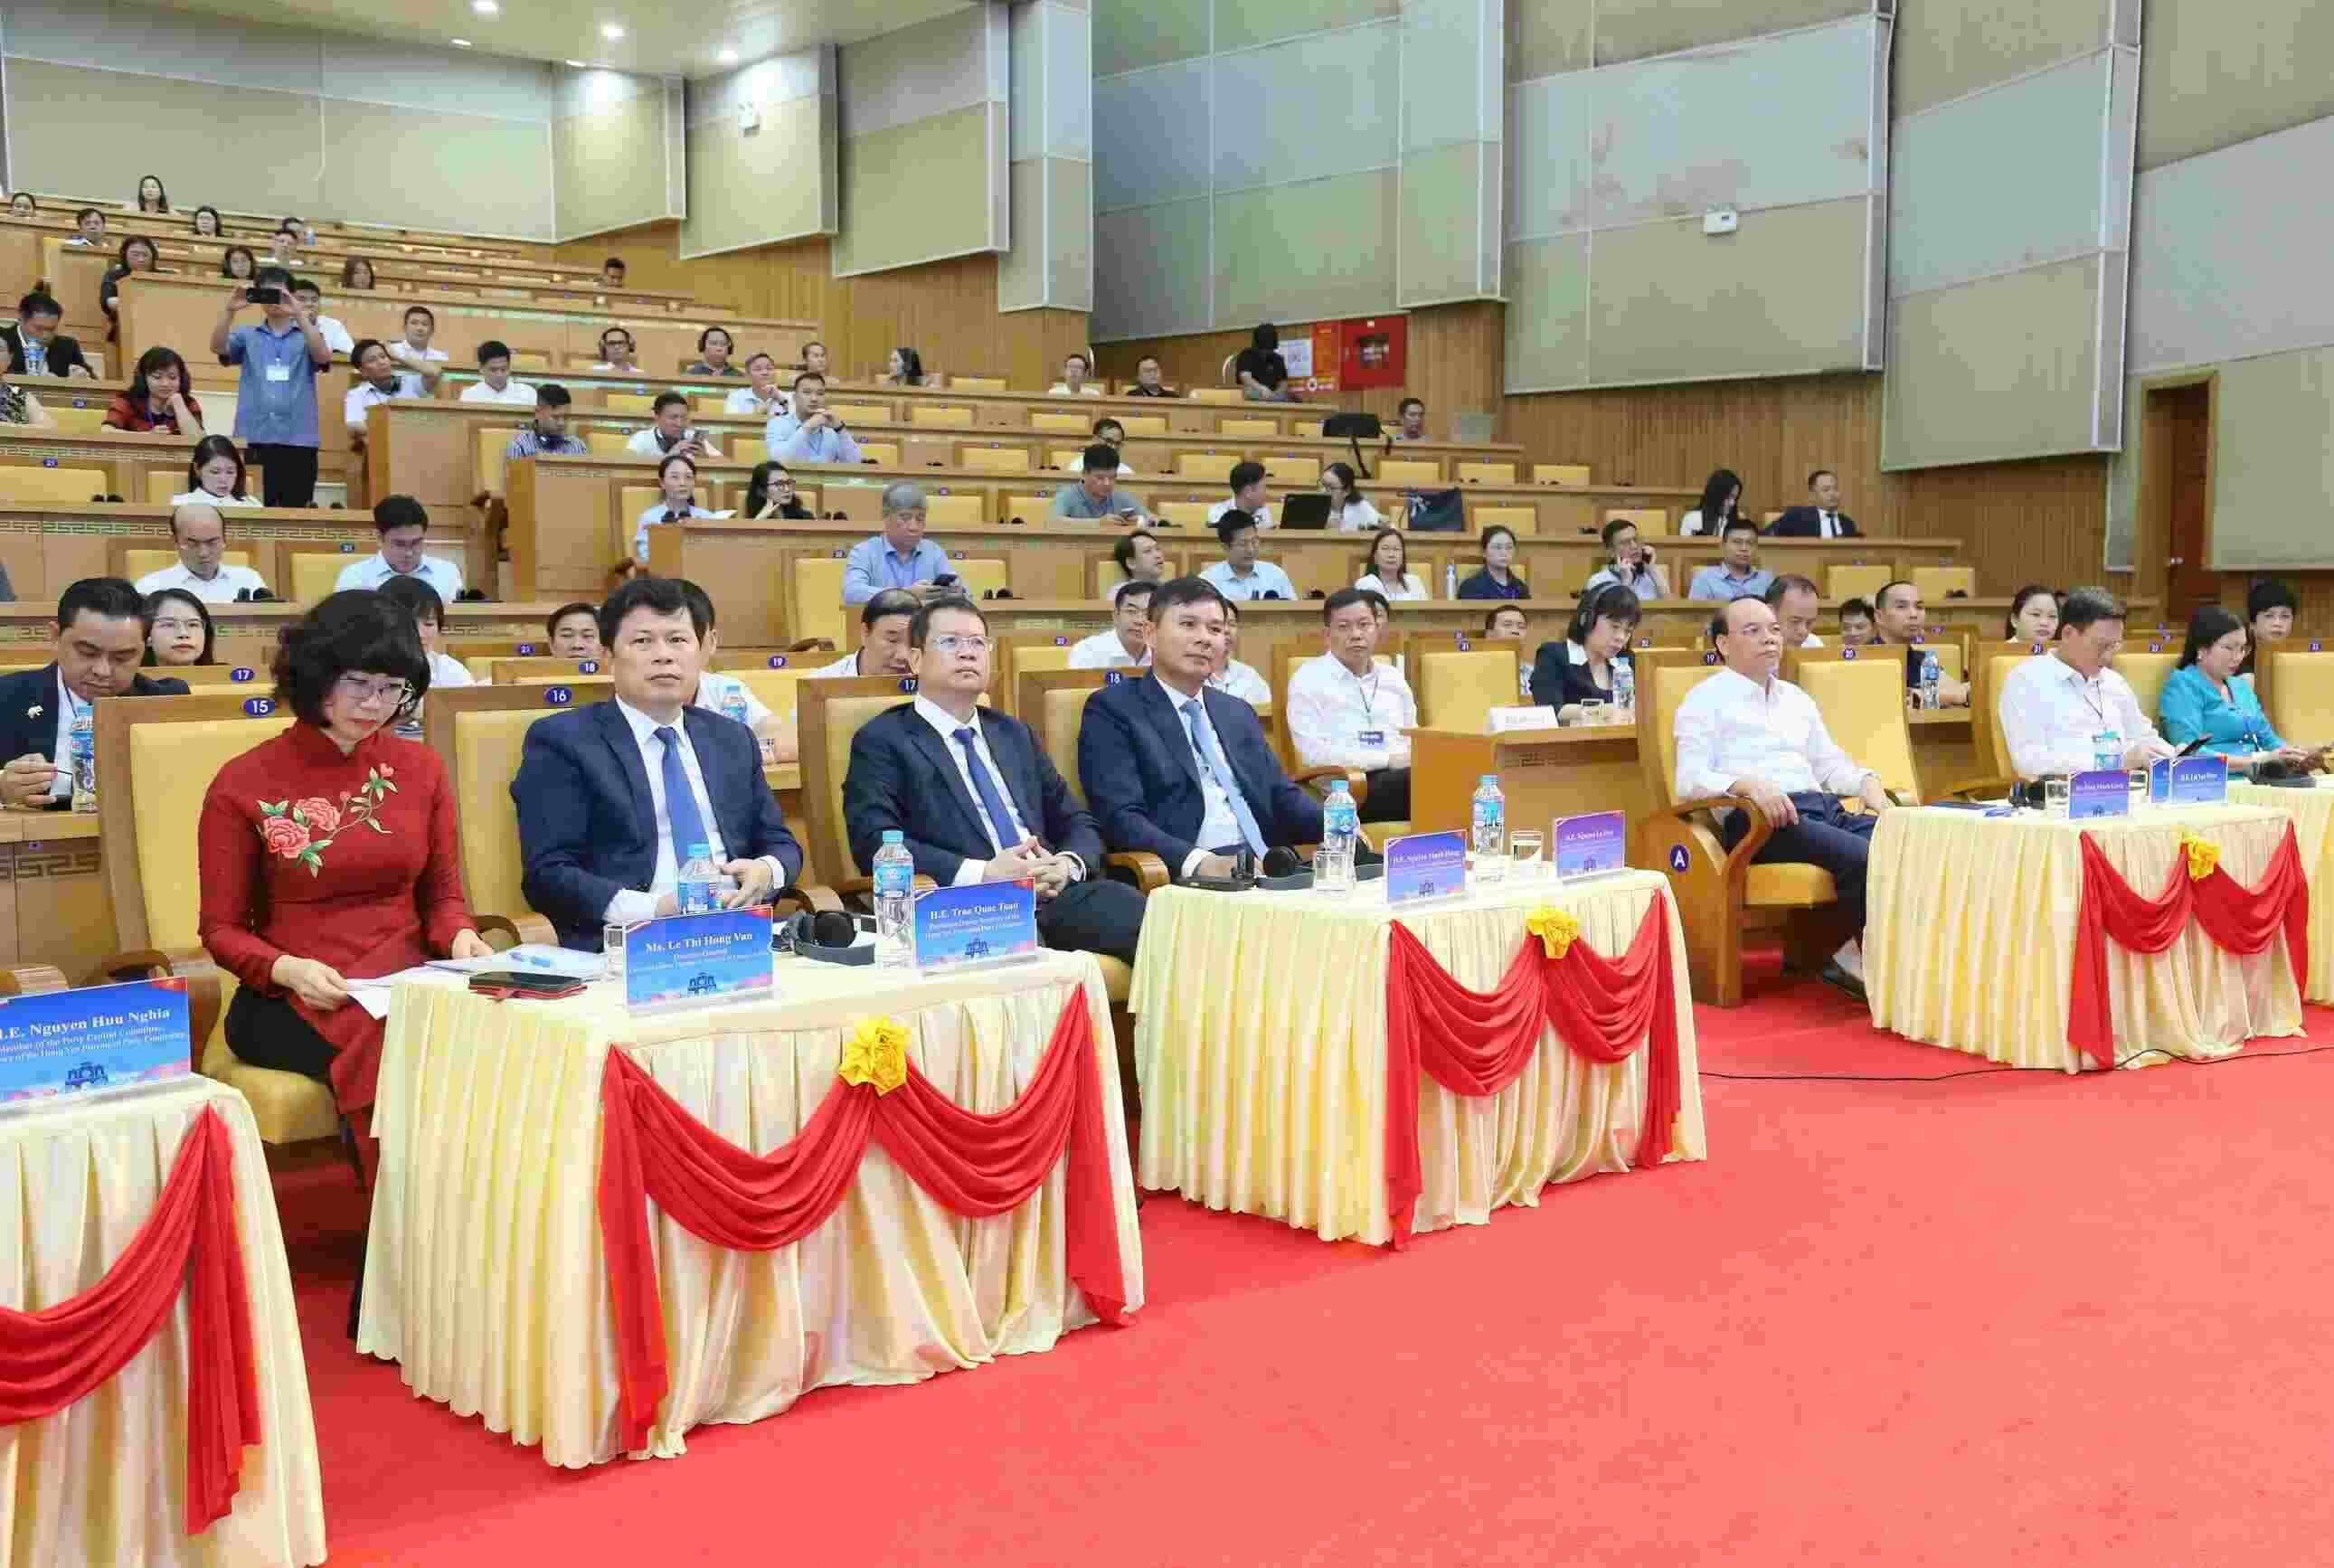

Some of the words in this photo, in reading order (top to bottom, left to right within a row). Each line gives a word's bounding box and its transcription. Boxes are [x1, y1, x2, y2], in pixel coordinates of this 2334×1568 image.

[773, 657, 783, 666] 19
[238, 669, 250, 680] 17
[553, 690, 566, 702] 16
[252, 701, 269, 713] 15
[1673, 849, 1687, 868] A
[646, 943, 666, 954] Ms.
[685, 938, 702, 949] Thi
[733, 931, 753, 941] Van
[30, 1018, 88, 1037] Nguyen
[92, 1014, 124, 1028] Huu
[128, 1007, 171, 1024] Nghia
